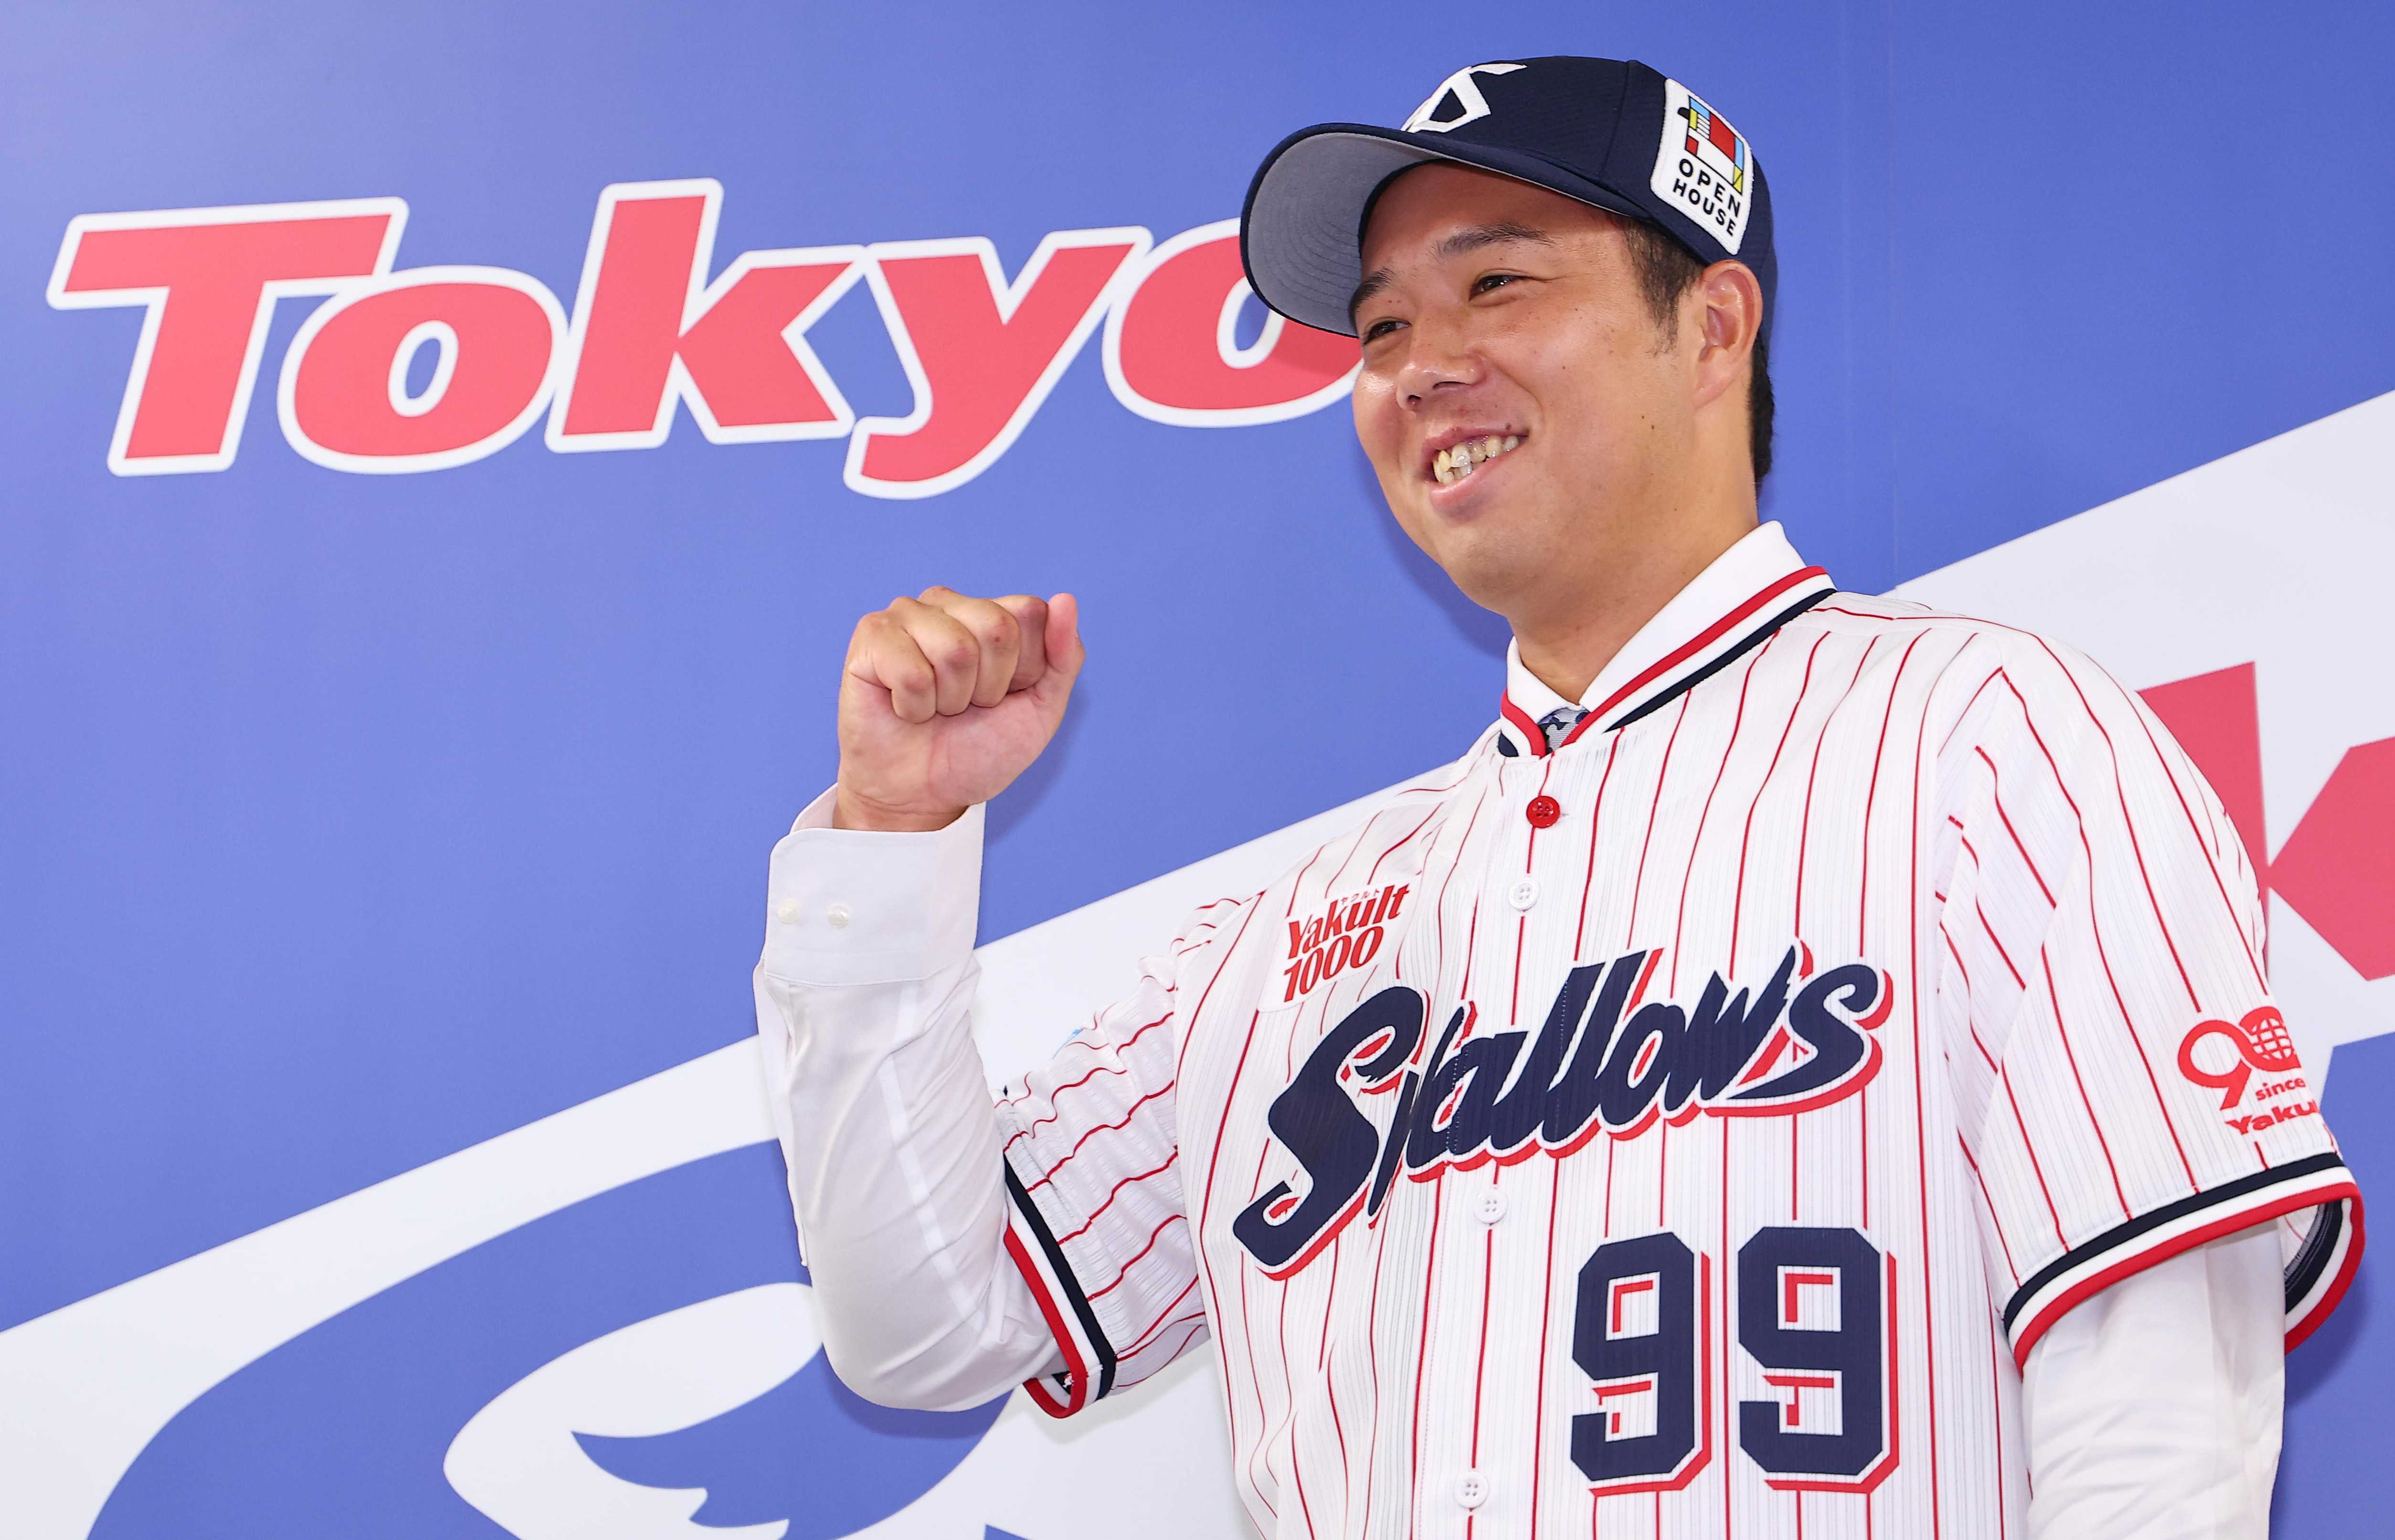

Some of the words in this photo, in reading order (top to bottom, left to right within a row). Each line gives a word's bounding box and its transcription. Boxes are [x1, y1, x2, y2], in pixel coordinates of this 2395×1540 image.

[1673, 178, 1736, 236] HOUSE
[1678, 158, 1741, 218] OPEN
[47, 178, 1366, 500] Tokyo
[1287, 883, 1410, 960] Yakult
[1341, 888, 1380, 905] ヤクルト
[1283, 926, 1384, 1003] 1000
[2225, 1099, 2320, 1136] Yaku
[2255, 1077, 2306, 1101] since
[1570, 1226, 1900, 1498] 99
